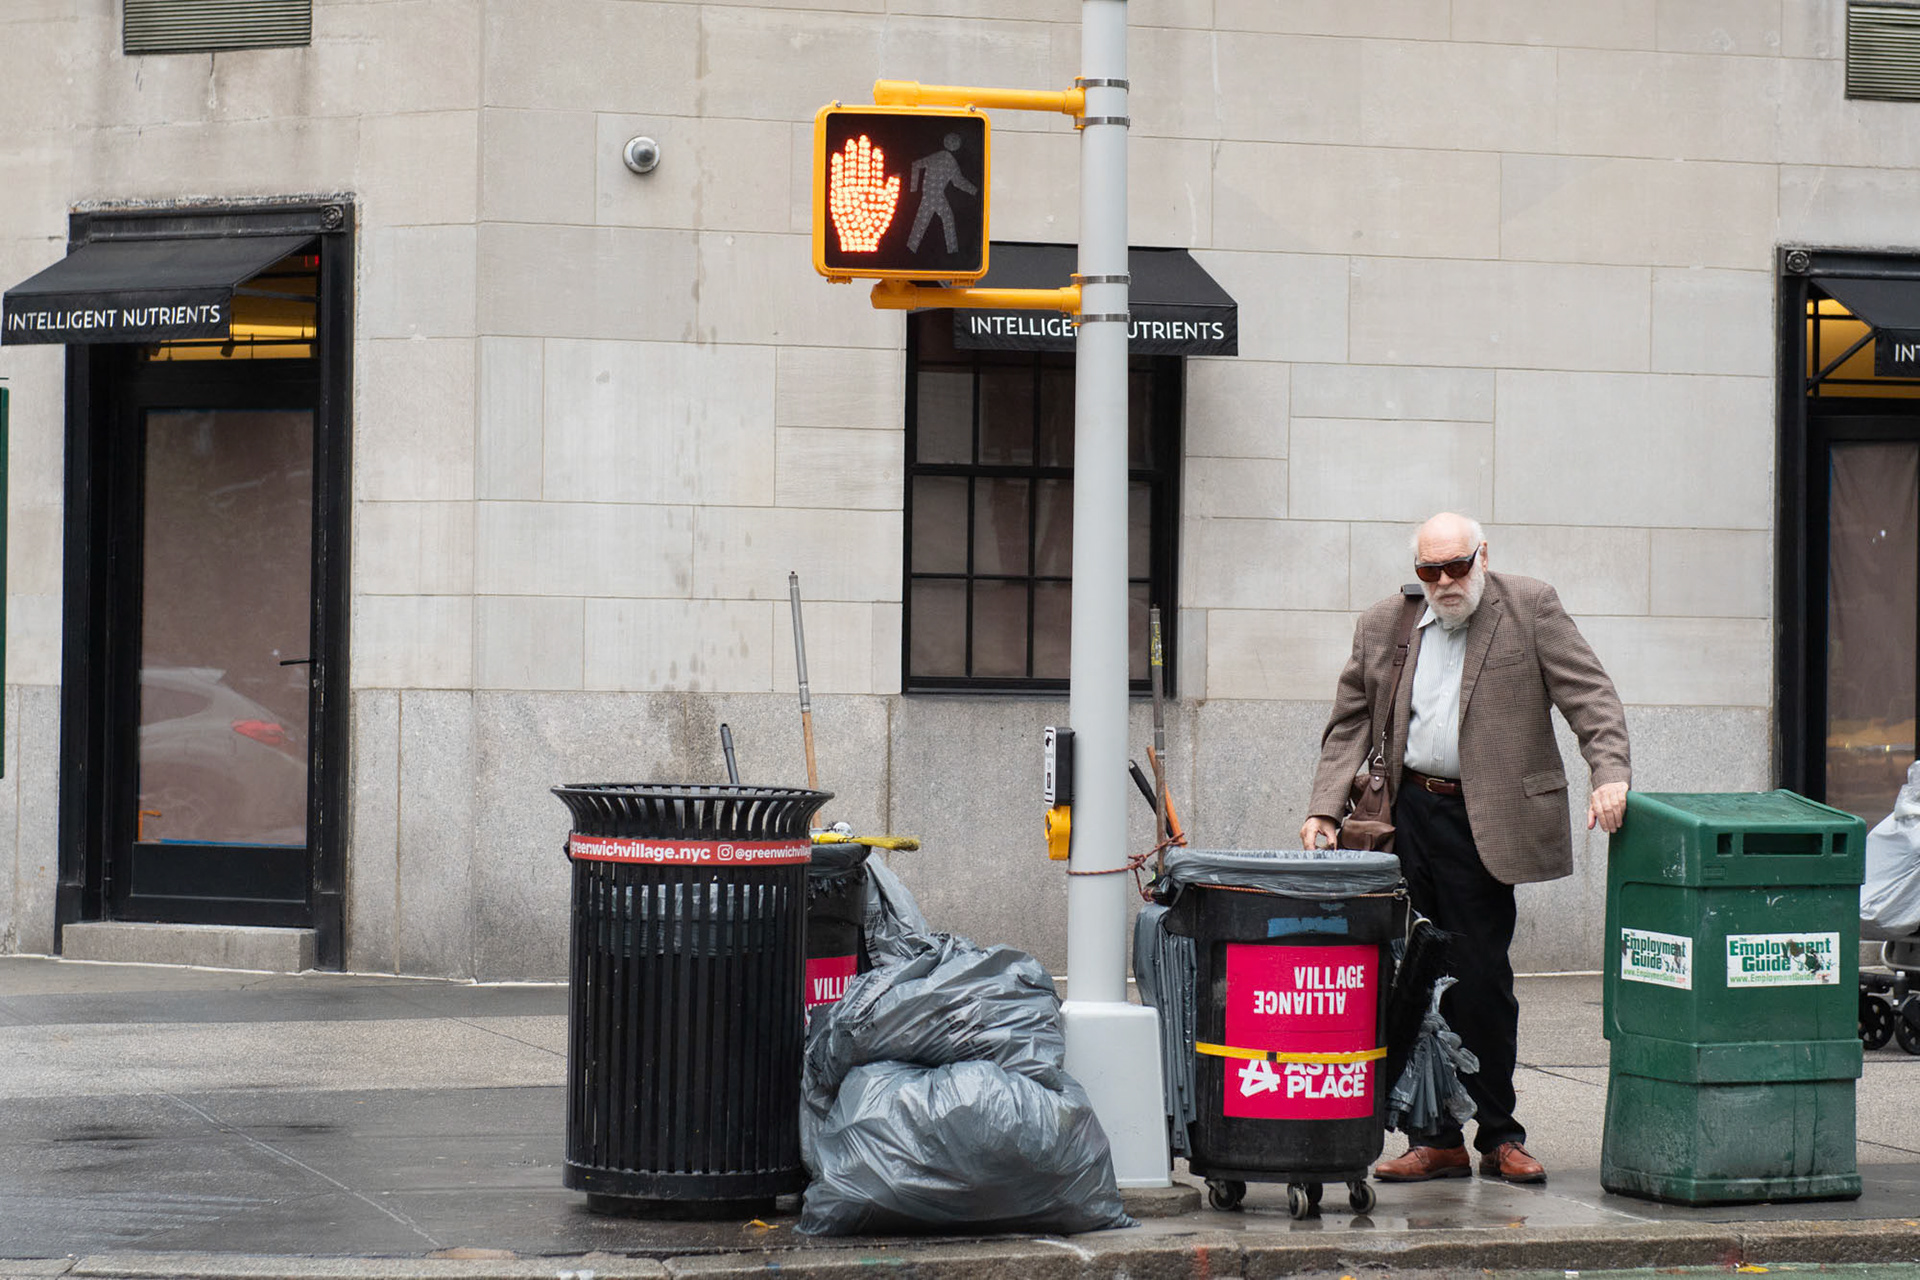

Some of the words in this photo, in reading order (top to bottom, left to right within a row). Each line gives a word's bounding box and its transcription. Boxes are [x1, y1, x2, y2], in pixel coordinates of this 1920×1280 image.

[8, 309, 118, 331] INTELLIGENT
[122, 305, 221, 328] NUTRIENTS
[970, 316, 1078, 337] INTELLIGE
[1127, 321, 1225, 340] UTRIENTS
[571, 839, 711, 863] greenwichvillage.nyc
[1632, 951, 1662, 970] Guide
[1742, 956, 1791, 973] Guide
[813, 974, 857, 1000] VILLA
[1293, 965, 1365, 989] VILLAGE
[1253, 990, 1346, 1015] ALLIANCE
[1286, 1075, 1365, 1098] PLACE
